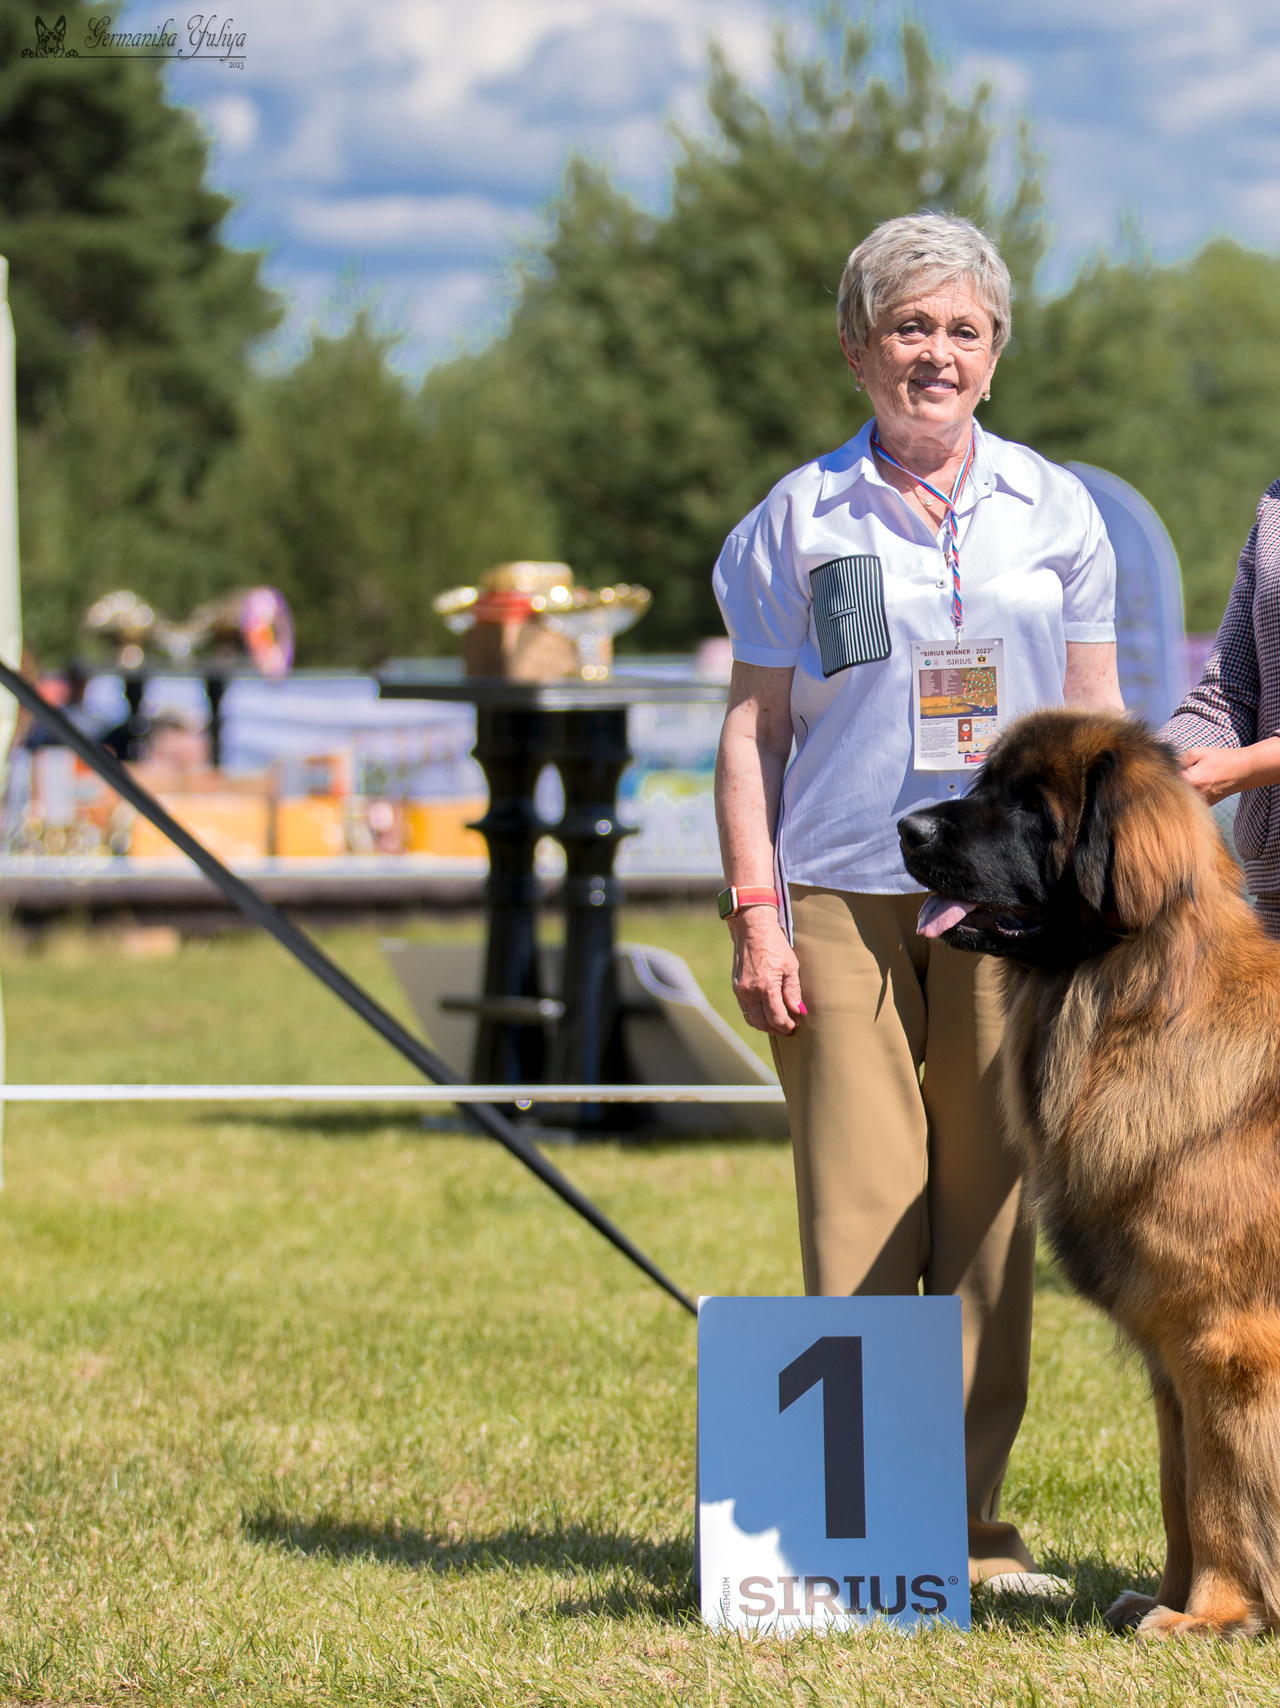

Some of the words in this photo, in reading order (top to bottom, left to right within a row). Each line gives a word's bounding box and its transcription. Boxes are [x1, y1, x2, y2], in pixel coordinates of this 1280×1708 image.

[946, 648, 971, 656] WINNER
[947, 658, 973, 666] SIRIUS
[779, 1335, 866, 1539] 1
[723, 1577, 731, 1617] PREMIUM
